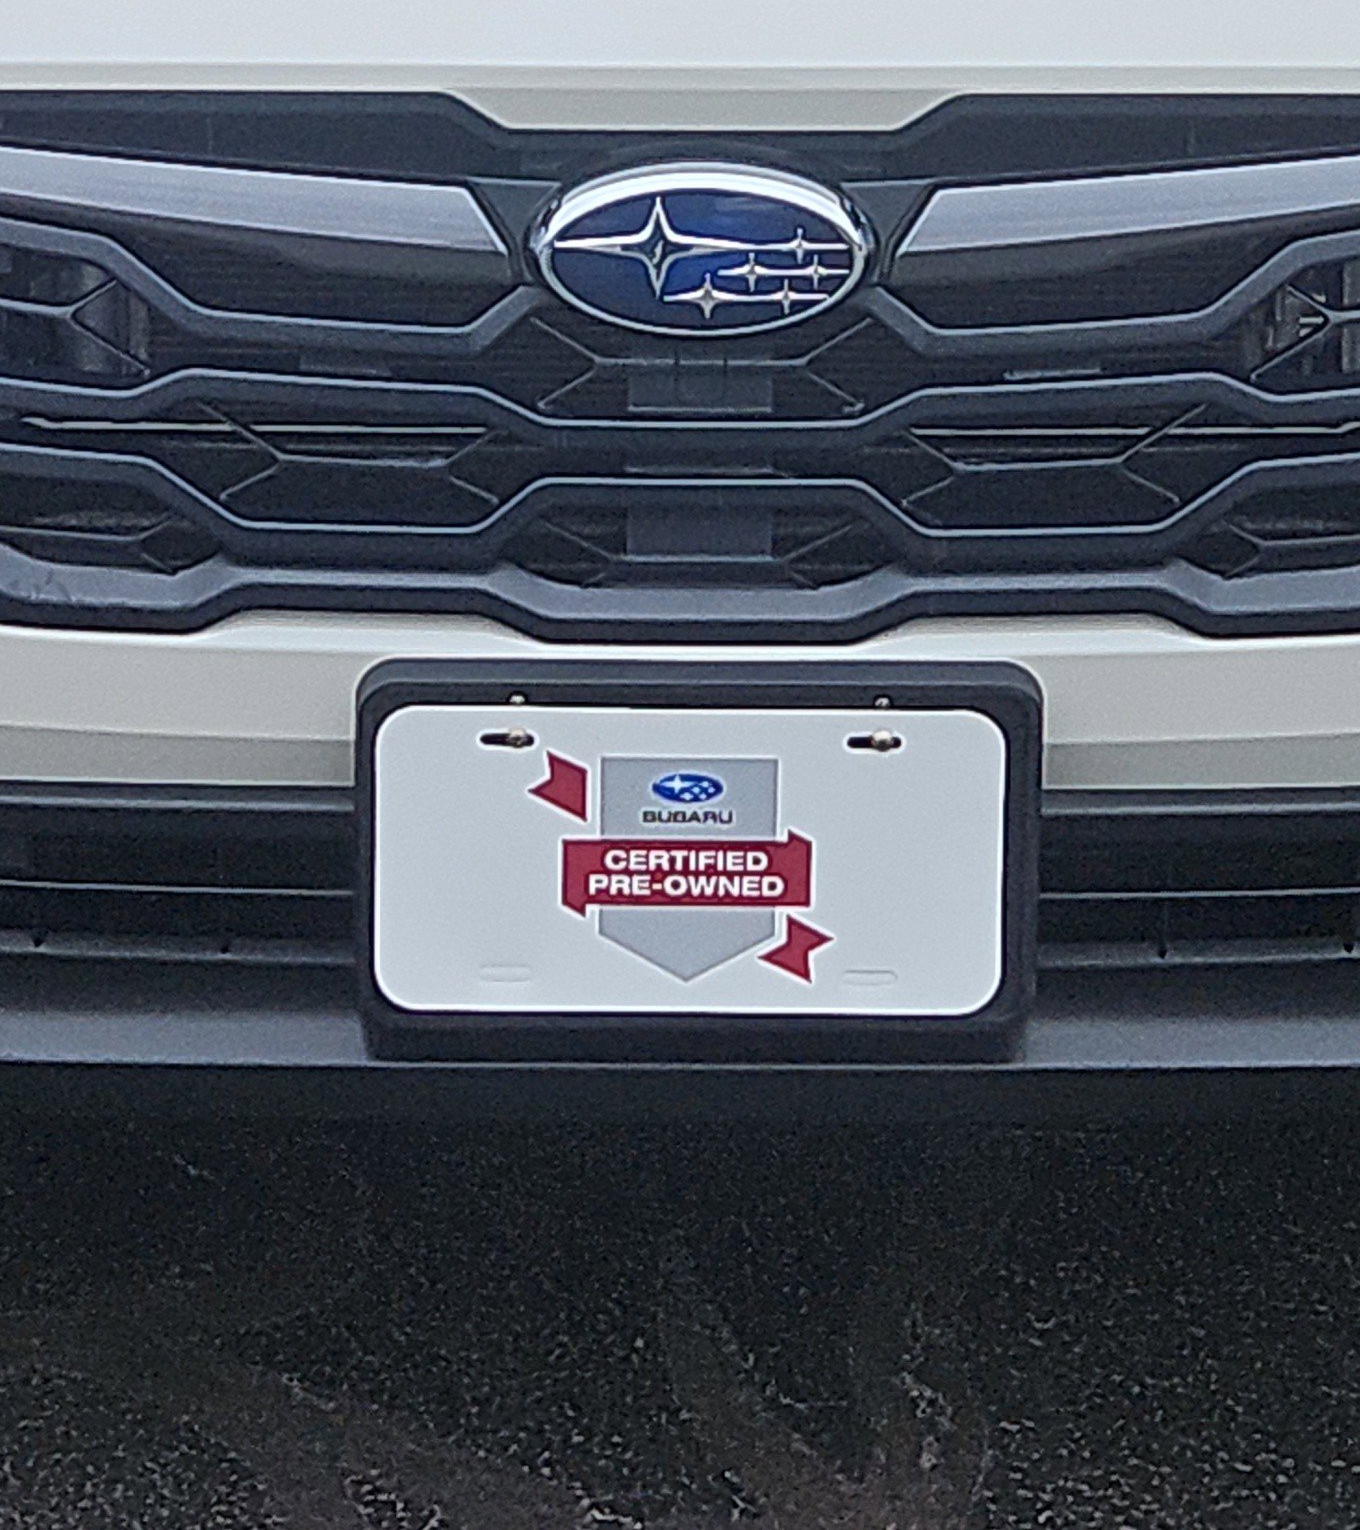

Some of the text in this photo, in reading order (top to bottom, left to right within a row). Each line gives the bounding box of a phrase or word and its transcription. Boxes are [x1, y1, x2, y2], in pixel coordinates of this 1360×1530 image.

[641, 809, 734, 824] SUBARU
[603, 848, 769, 872] CERTIFIED
[588, 872, 786, 898] PRE-OWNED
